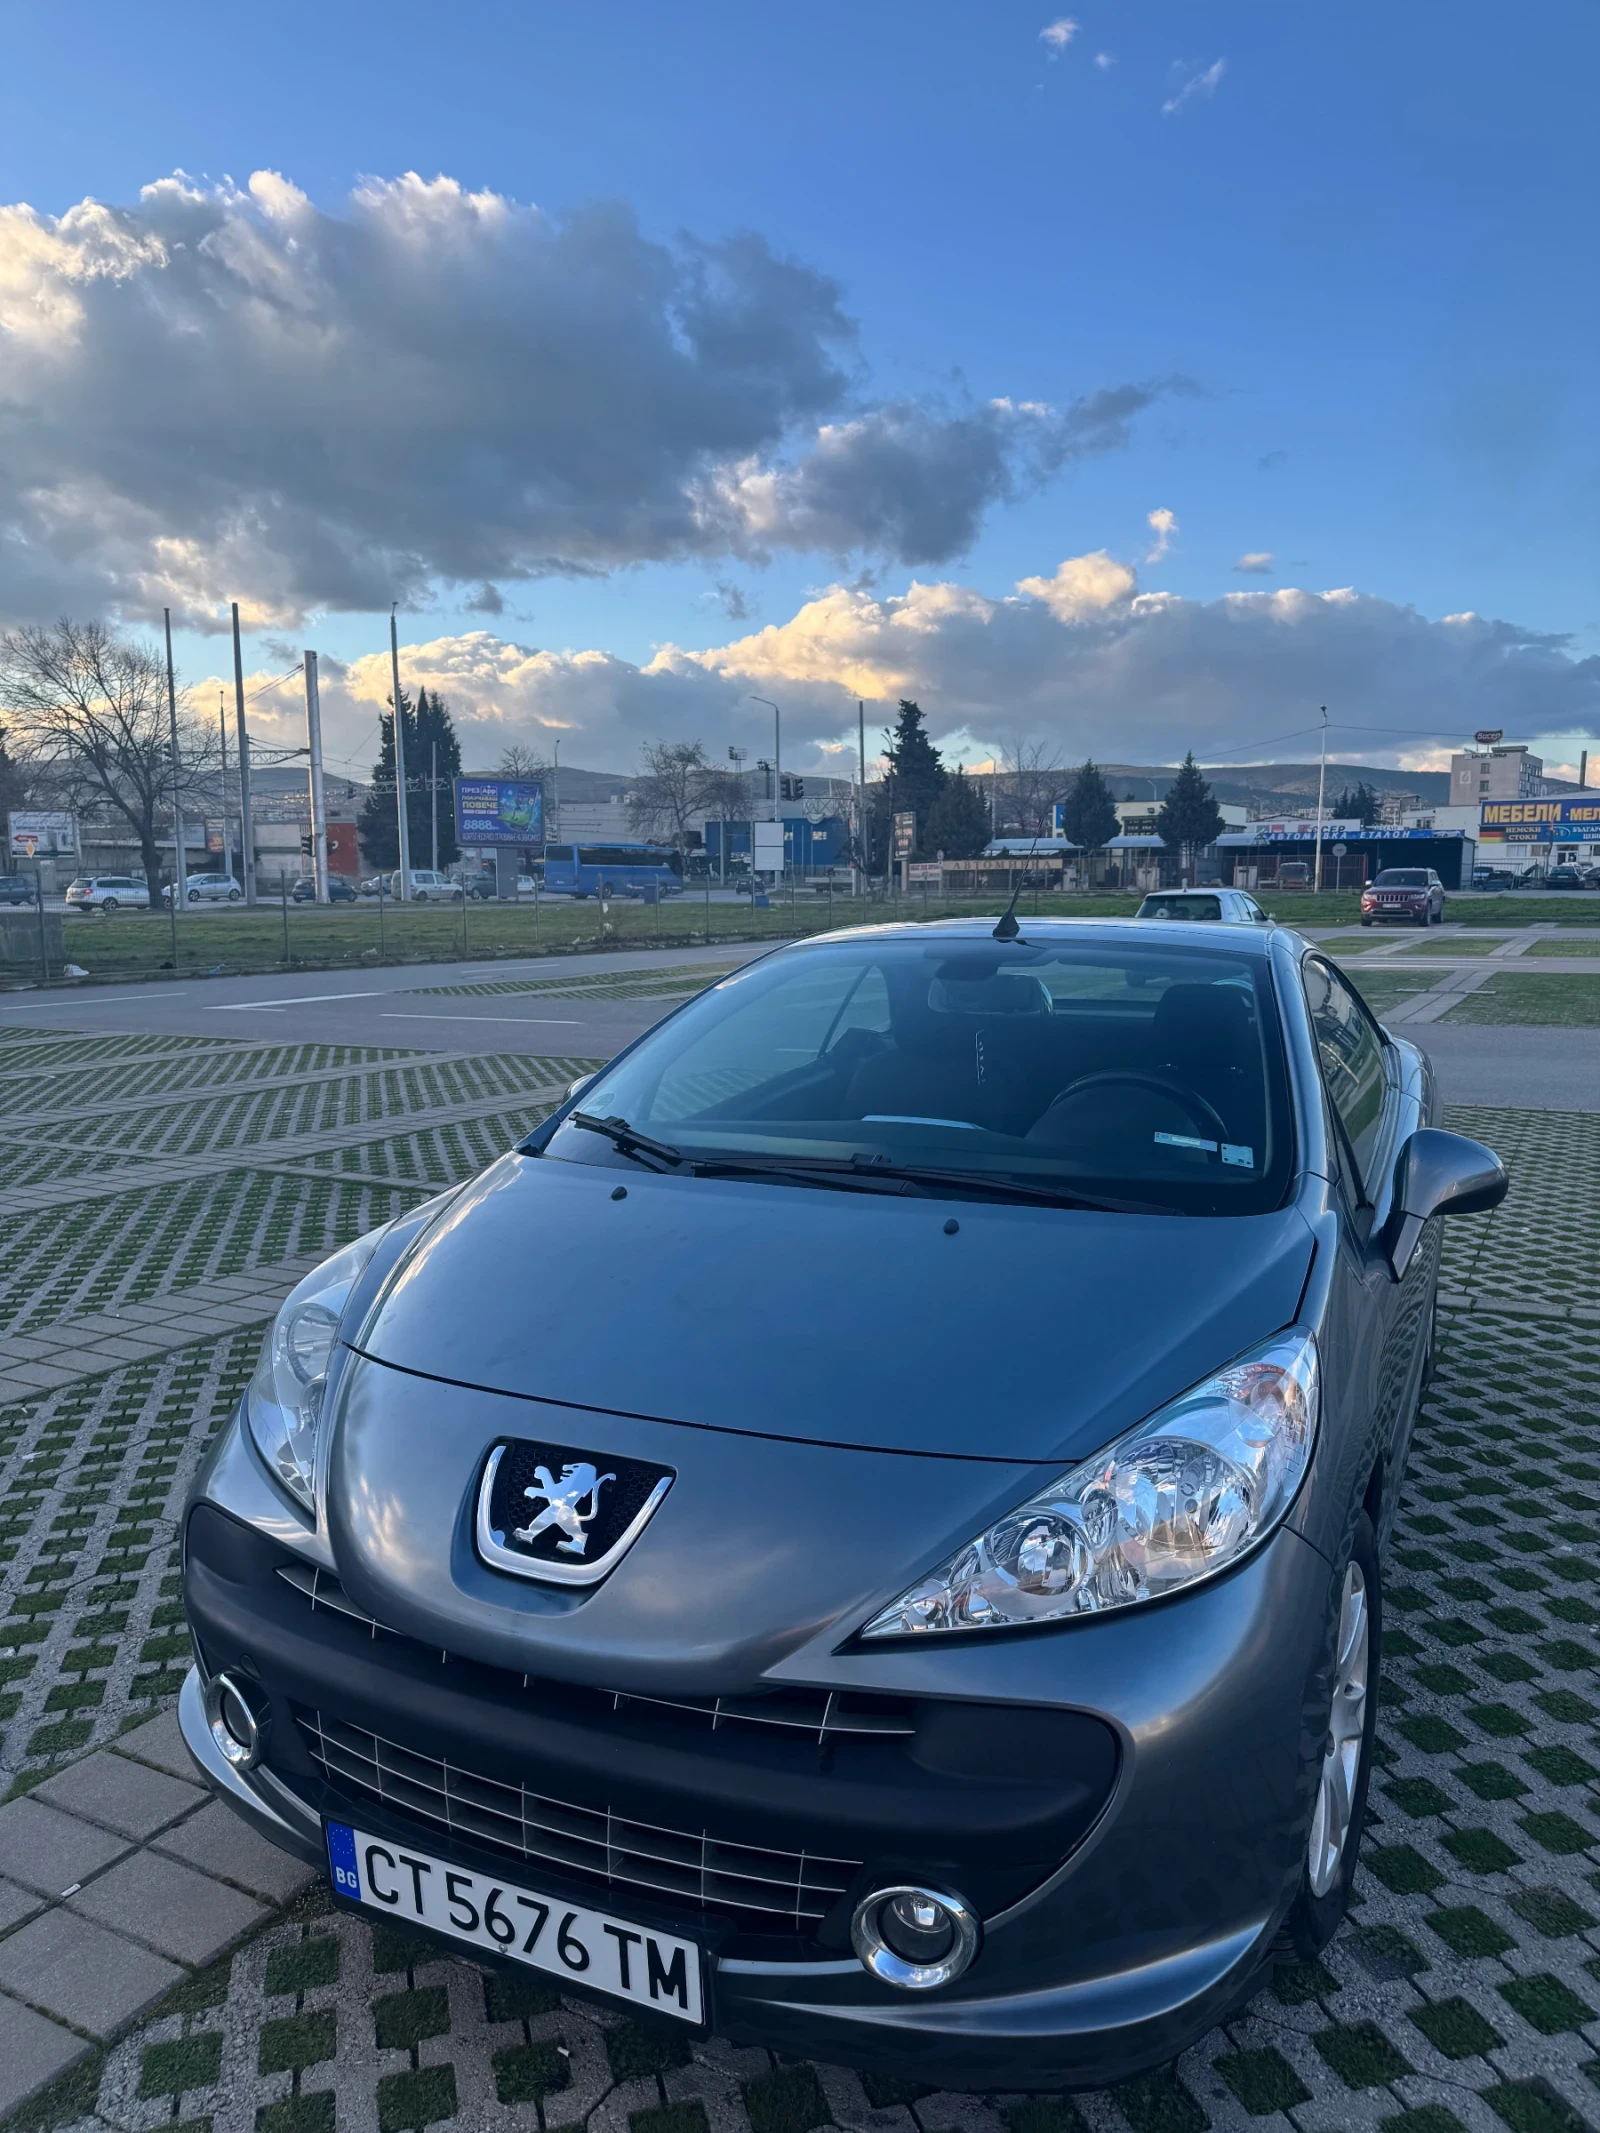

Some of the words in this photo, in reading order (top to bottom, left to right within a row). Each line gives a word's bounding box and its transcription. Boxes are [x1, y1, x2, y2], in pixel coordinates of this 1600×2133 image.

[462, 801, 499, 809] ПОВЕЧЕ
[1483, 803, 1562, 824] МЕБЕЛИ
[1359, 831, 1410, 839] ЕТАЛОН
[336, 1866, 357, 1888] BG
[365, 1844, 432, 1915] CT
[445, 1872, 591, 1972] 5676
[603, 1923, 690, 2010] TM
